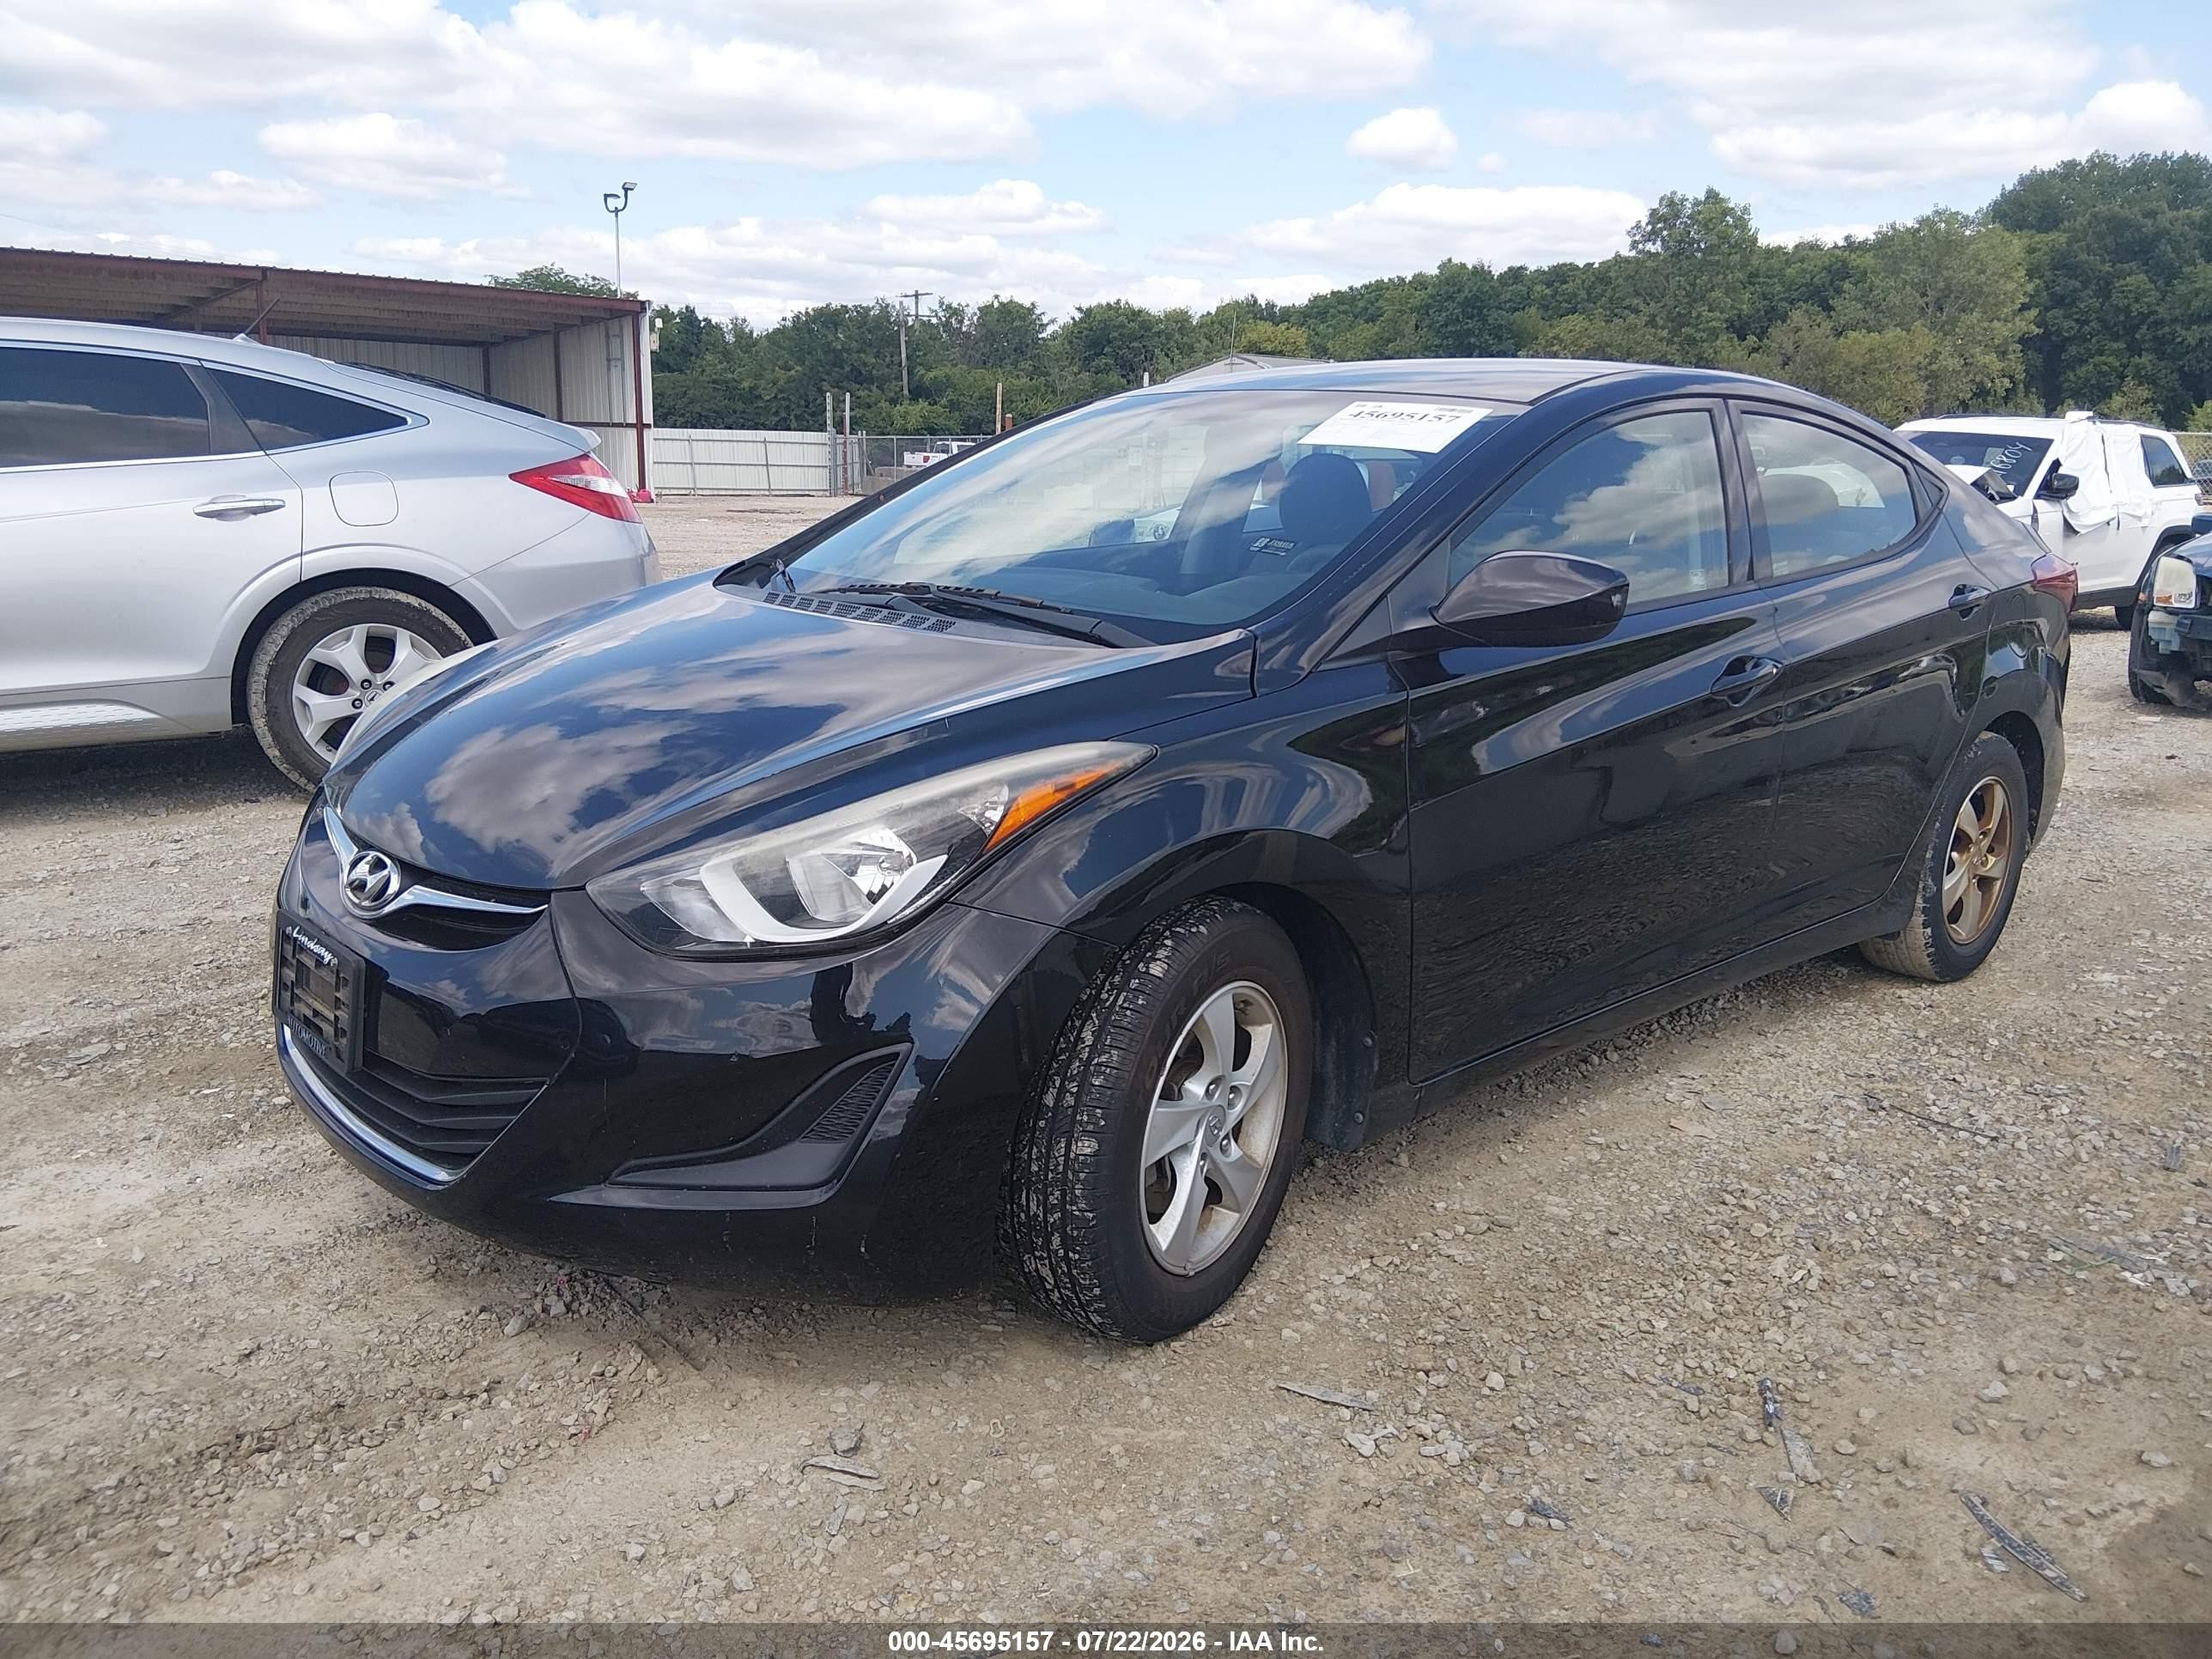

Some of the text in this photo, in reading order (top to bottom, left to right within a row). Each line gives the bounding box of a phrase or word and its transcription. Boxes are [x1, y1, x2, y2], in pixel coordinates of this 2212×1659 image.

[1349, 410, 1462, 424] 45695157
[293, 926, 334, 964] Lindsay
[289, 1015, 326, 1056] AUTOMOTIVE
